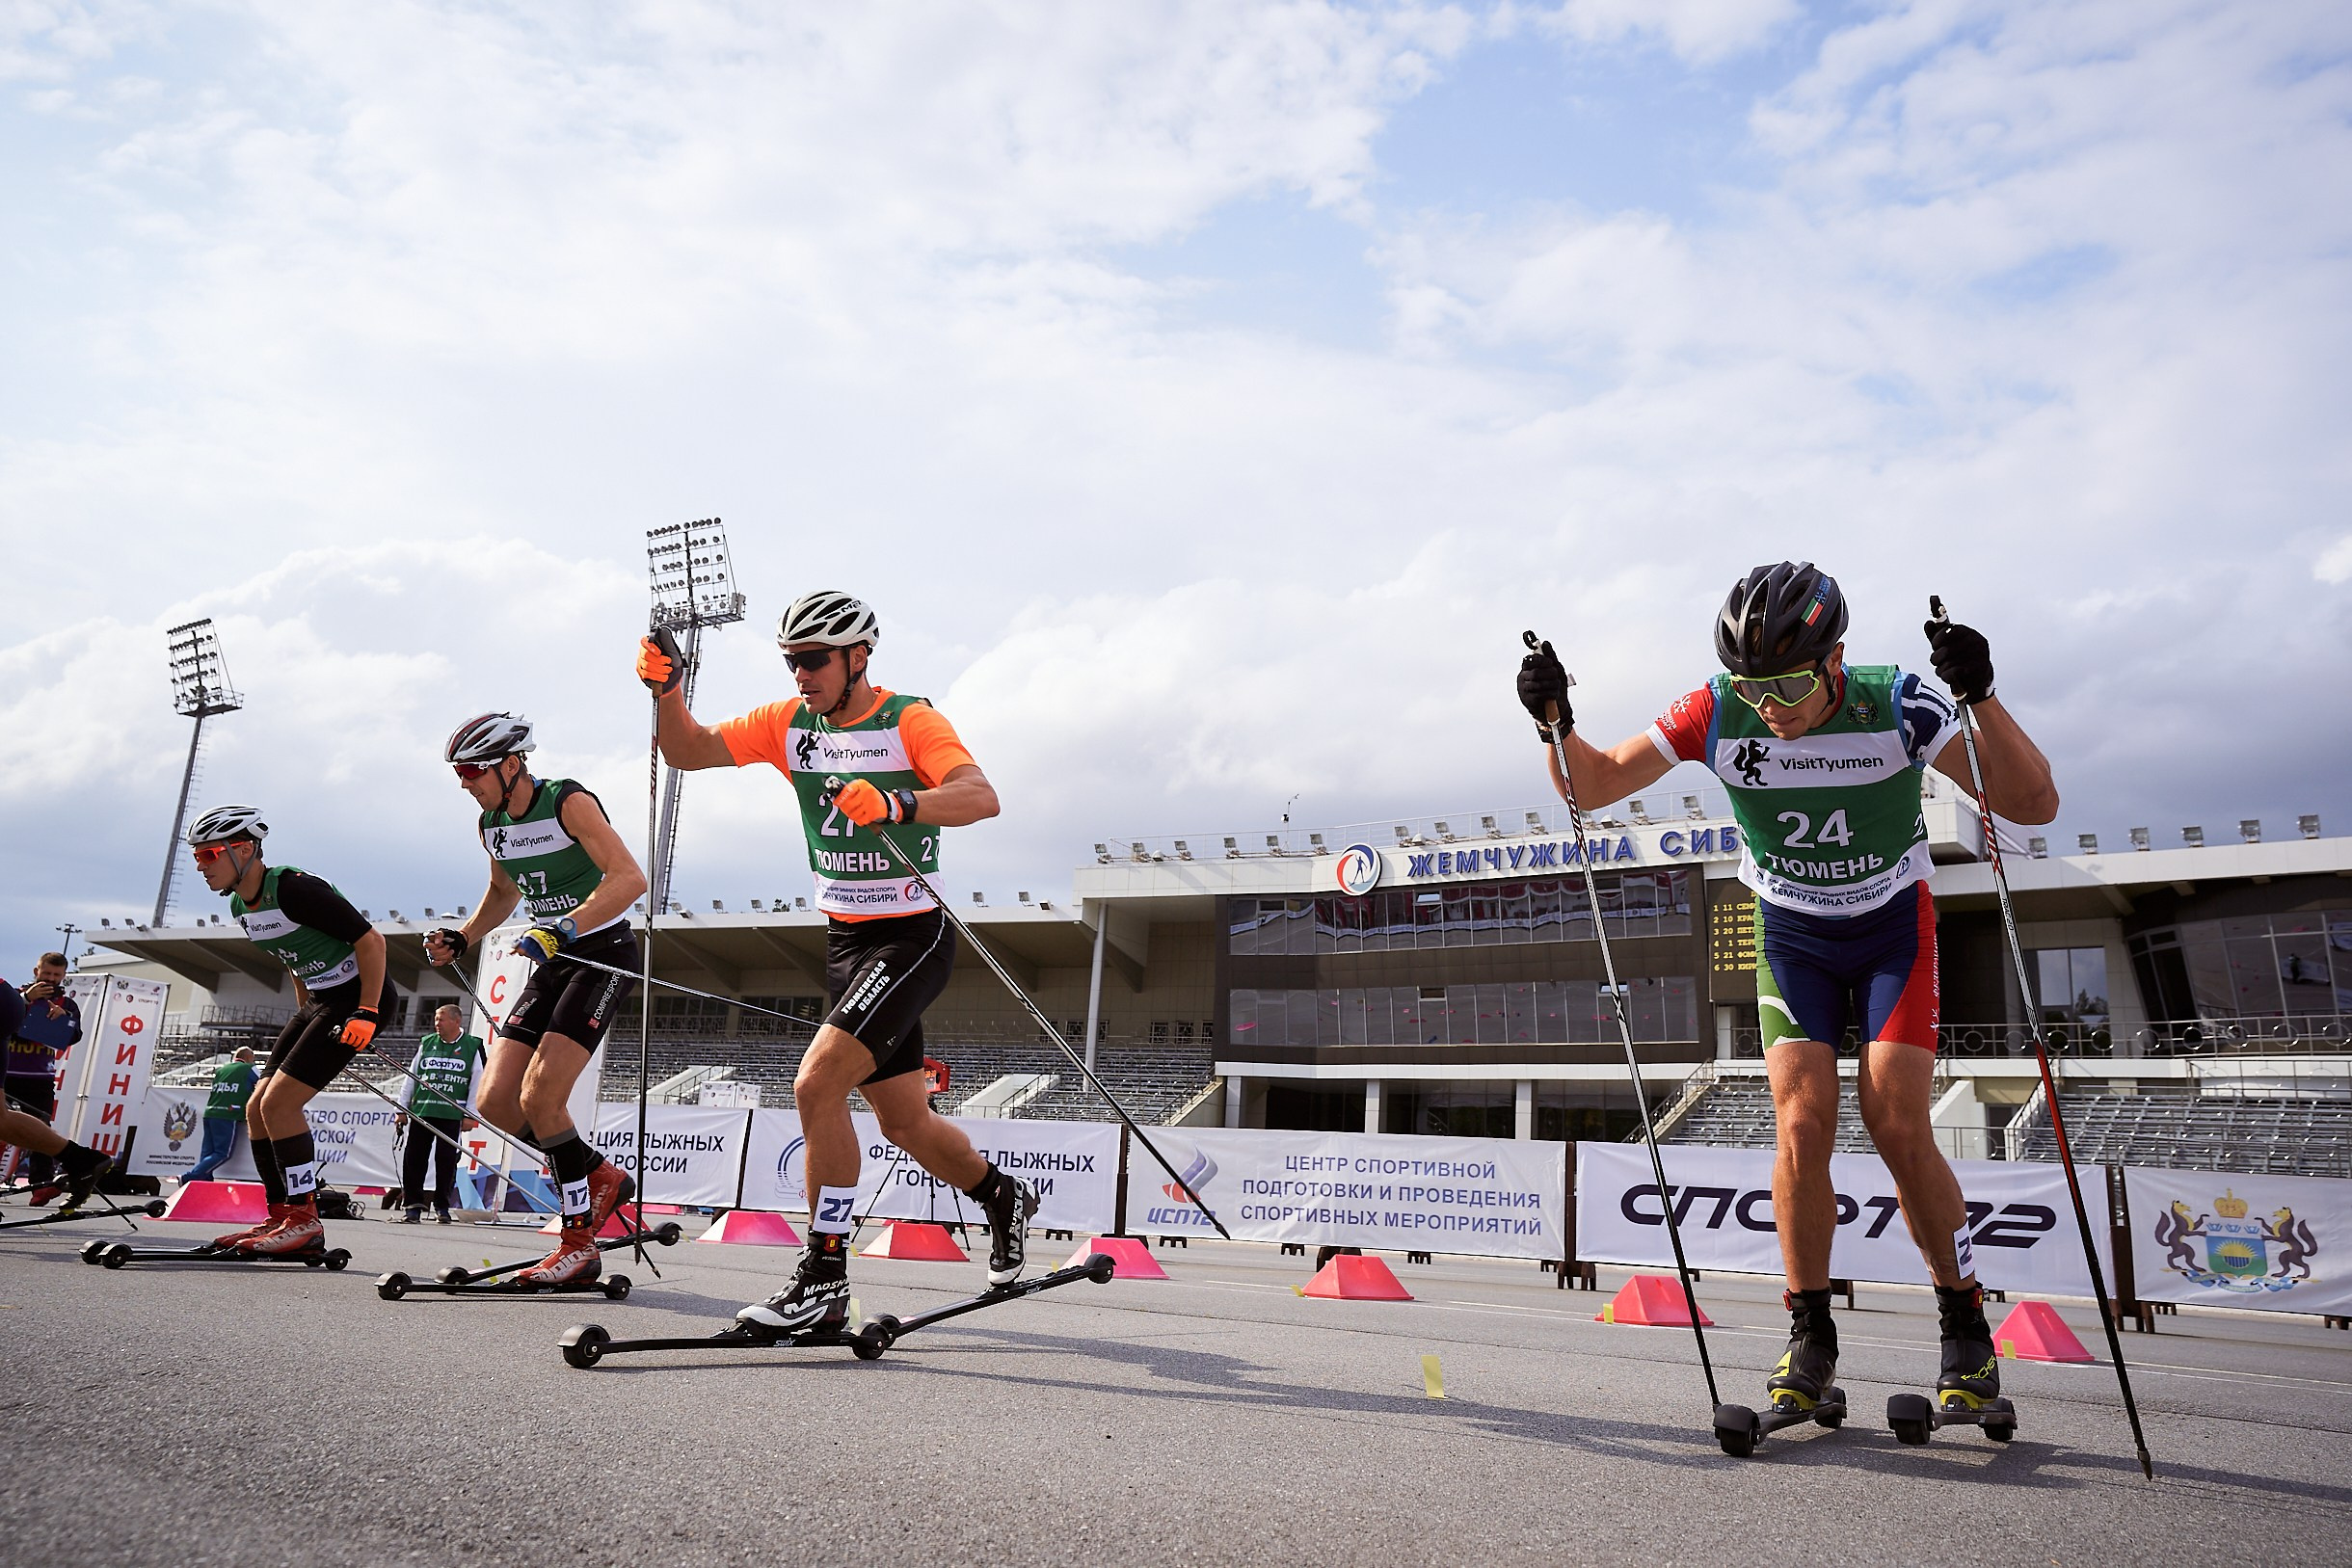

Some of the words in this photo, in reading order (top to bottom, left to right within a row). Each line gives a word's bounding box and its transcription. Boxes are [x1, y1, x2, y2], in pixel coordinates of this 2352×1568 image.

[1779, 757, 1884, 772] VisitTyumen
[1777, 808, 1855, 849] 24
[510, 834, 554, 849] VisitTyumen
[1407, 836, 1637, 877] ЖЕМЧУЖИНА
[1660, 826, 1738, 857] СИБ
[815, 848, 891, 872] ТЮМЕНЬ
[1765, 852, 1884, 881] ТЮМЕНЬ
[856, 892, 897, 904] СИБИРИ
[1770, 885, 1843, 907] ЖЕМЧУЖИНА
[1728, 939, 1733, 947] 1
[1714, 951, 1720, 960] 5
[1724, 950, 1734, 959] 21
[857, 974, 891, 1012] ОБЛАСТЬ
[428, 1059, 465, 1071] Фортум
[92, 1015, 144, 1156] ФИНИШ
[212, 1081, 240, 1094] ДЬЯ
[420, 1082, 454, 1093] СОРТА
[344, 1111, 395, 1127] СПОРТА
[996, 1150, 1095, 1173] ЛЫЖНЫХ
[1285, 1156, 1349, 1173] ЦЕНТР
[1354, 1157, 1496, 1180] СПОРТИВНОЙ
[288, 1169, 314, 1188] 14
[567, 1185, 588, 1208] 17
[1243, 1179, 1373, 1201] ПОДГОТОВКИ
[1379, 1185, 1392, 1202] И
[1399, 1186, 1540, 1209] ПРОВЕДЕНИЯ
[819, 1197, 855, 1223] 27
[1241, 1205, 1378, 1227] СПОРТИВНЫХ
[1384, 1211, 1541, 1236] МЕРОПРИЯТИЙ
